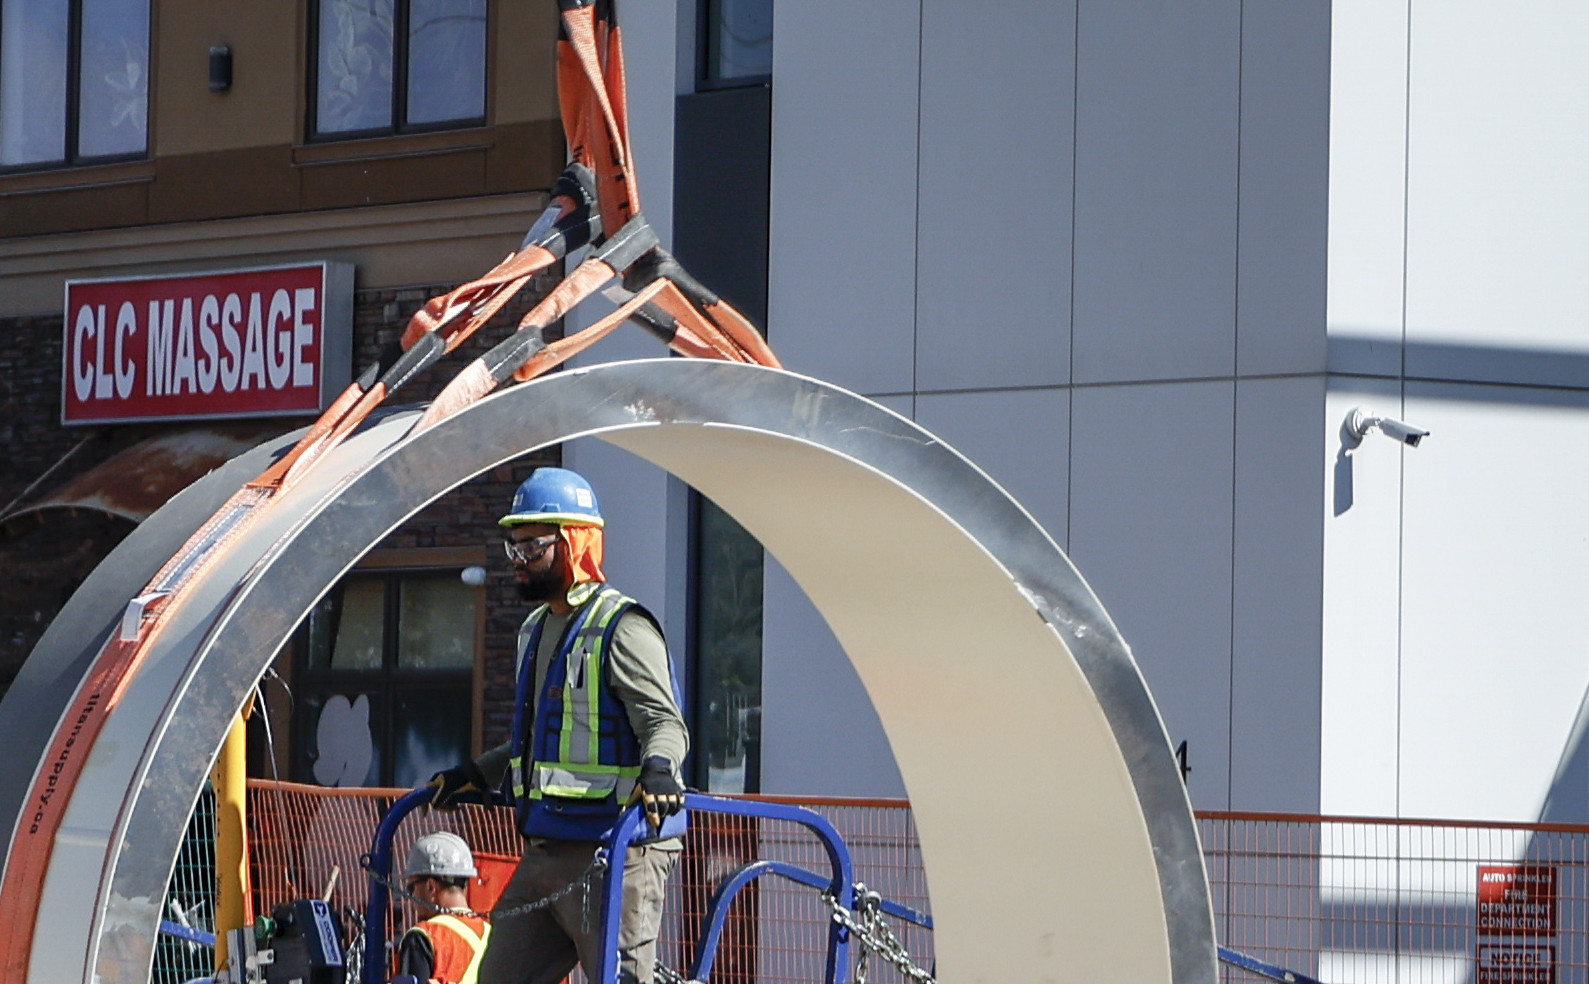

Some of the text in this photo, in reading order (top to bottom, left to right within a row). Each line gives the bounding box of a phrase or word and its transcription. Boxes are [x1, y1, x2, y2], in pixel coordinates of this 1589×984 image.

[73, 287, 315, 401] CLC MASSAGE
[29, 693, 100, 835] titansupply.ca
[1482, 873, 1552, 884] AUTO SPRINKLER
[1504, 889, 1528, 900] FIRE
[1481, 902, 1551, 914] DEPARTMENT
[1481, 917, 1551, 928] CONNECTION
[1491, 952, 1541, 966] NOTICE
